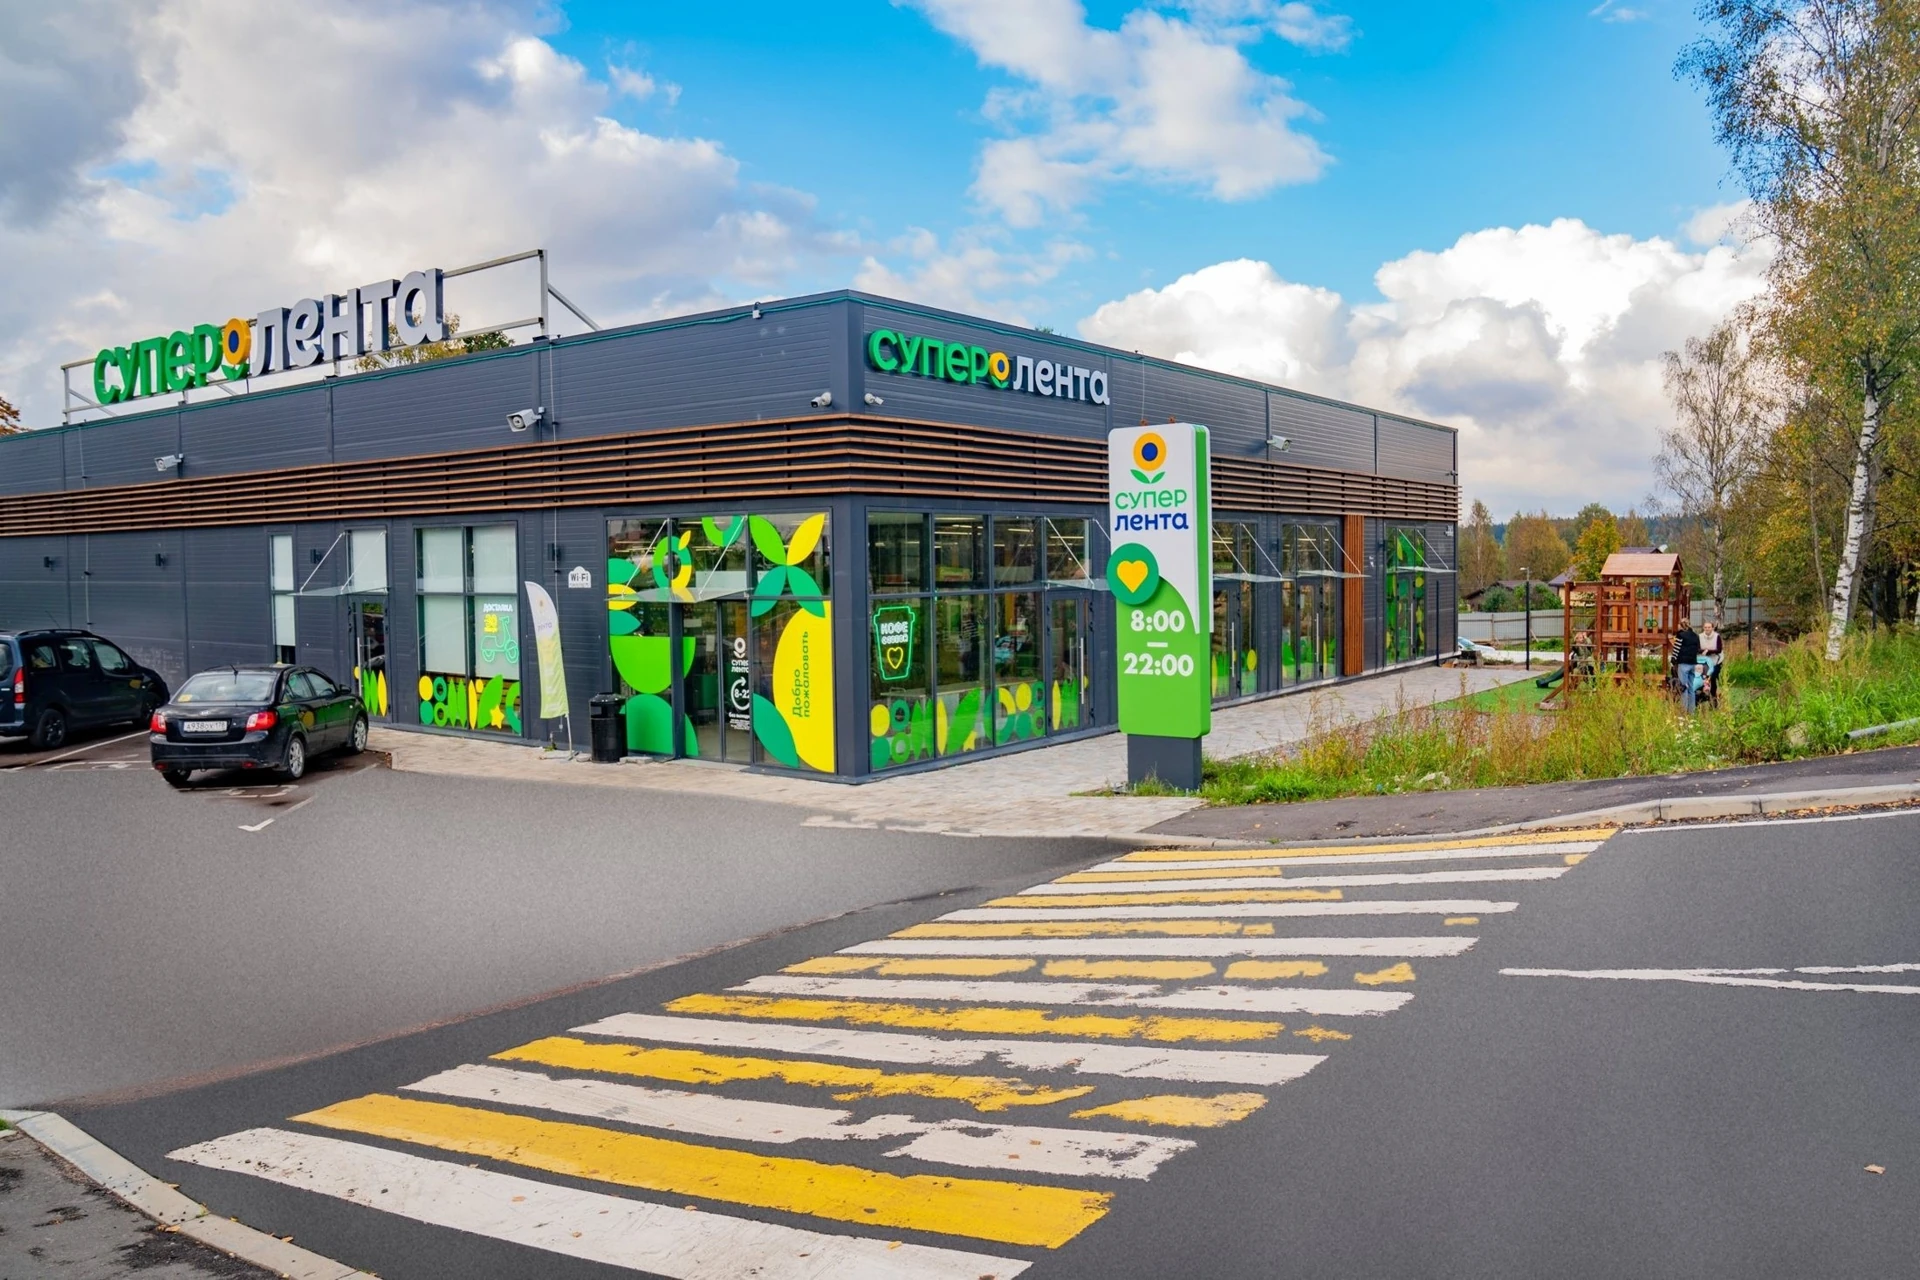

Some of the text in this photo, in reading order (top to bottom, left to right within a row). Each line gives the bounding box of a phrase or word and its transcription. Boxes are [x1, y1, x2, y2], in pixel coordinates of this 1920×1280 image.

[1130, 609, 1185, 633] 8:00
[802, 631, 810, 718] пожаловать
[1123, 652, 1194, 677] 22:00
[792, 669, 803, 717] Добро
